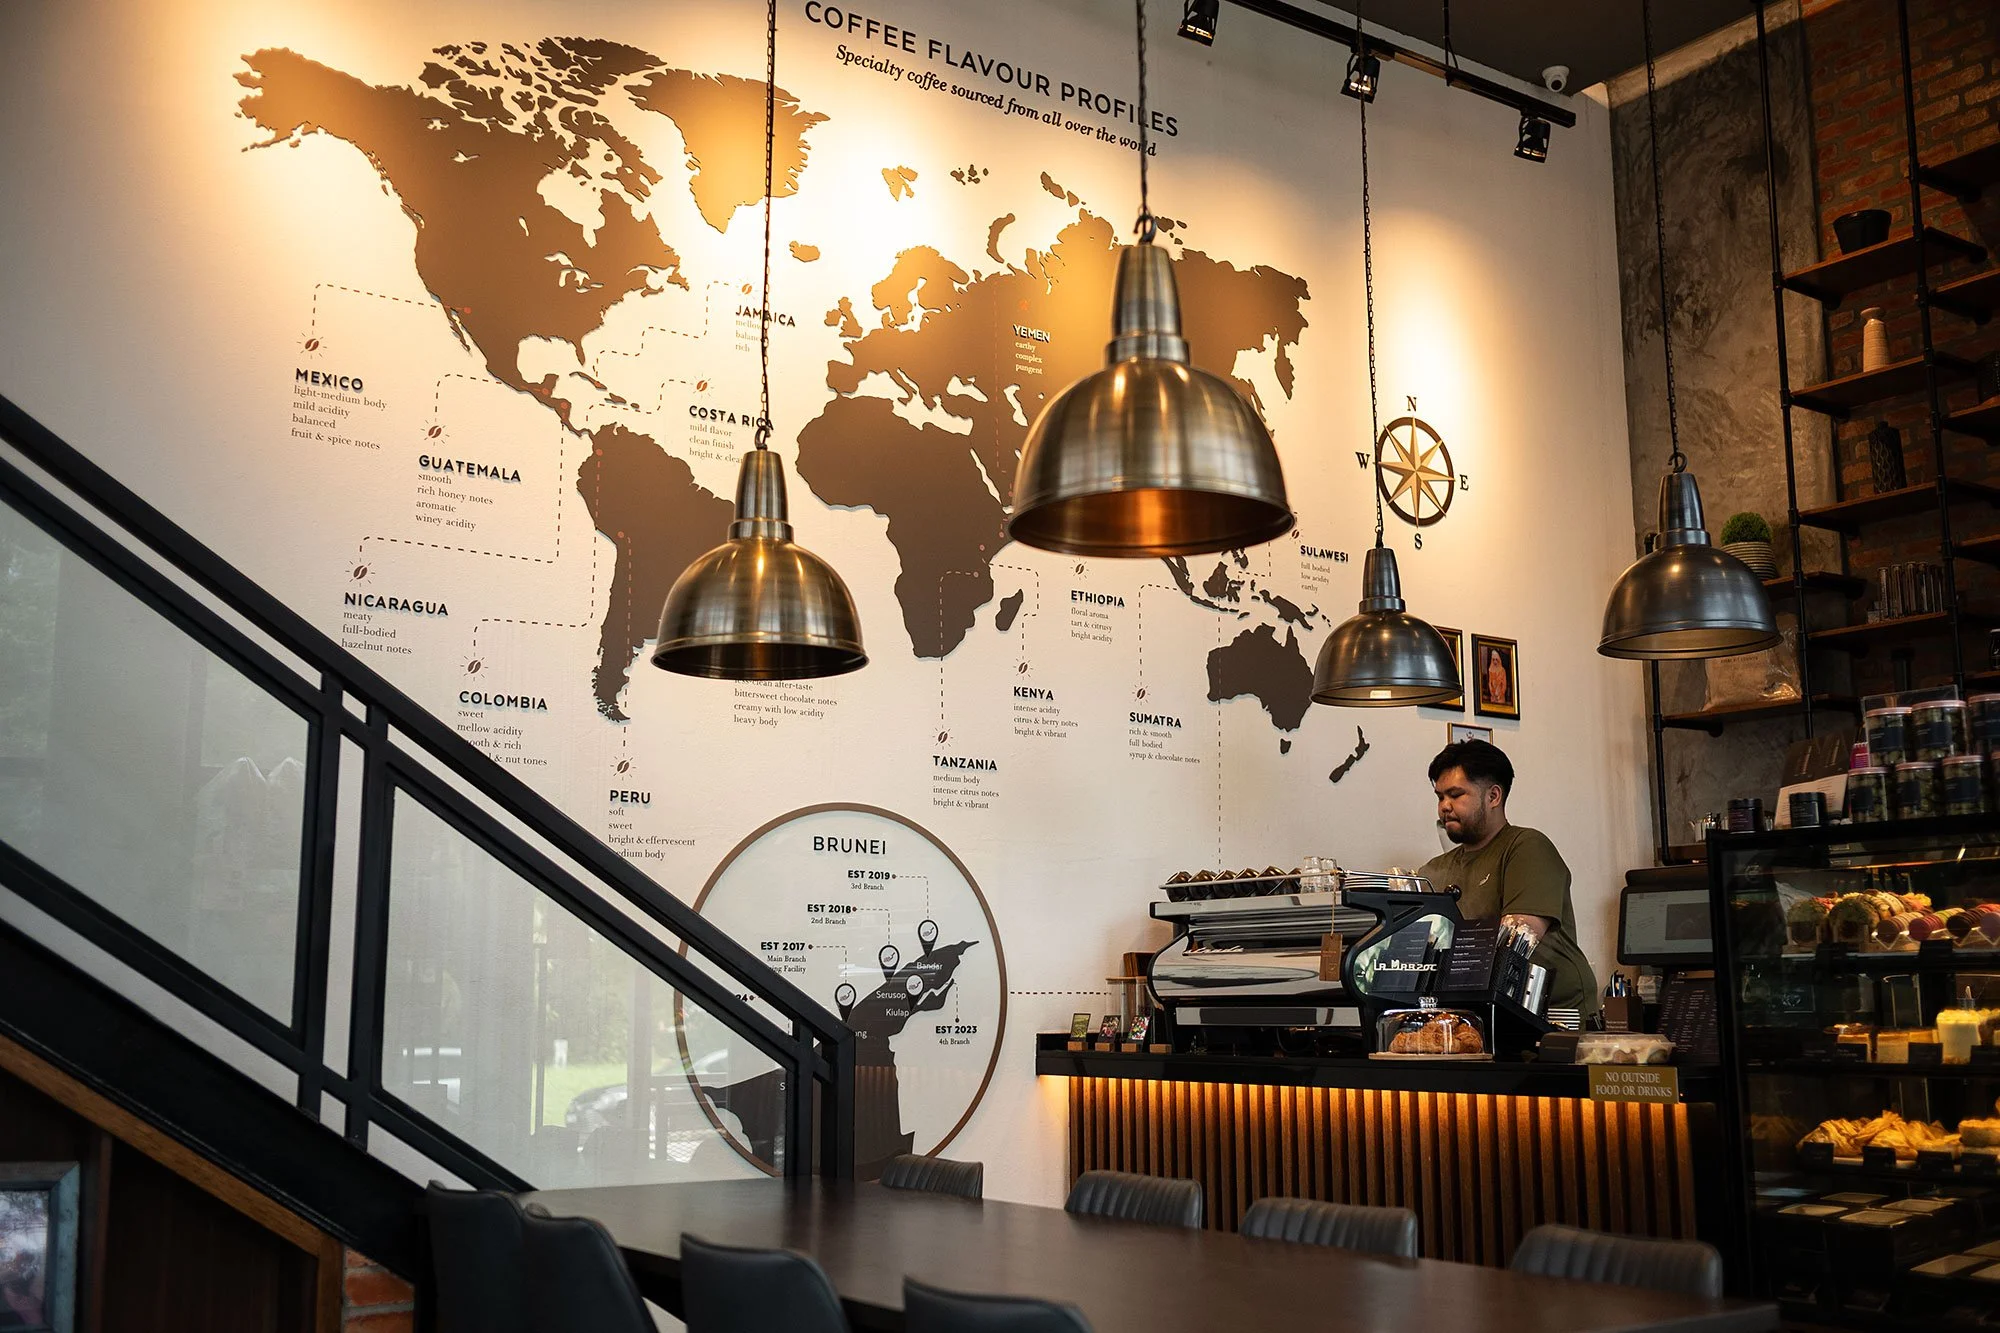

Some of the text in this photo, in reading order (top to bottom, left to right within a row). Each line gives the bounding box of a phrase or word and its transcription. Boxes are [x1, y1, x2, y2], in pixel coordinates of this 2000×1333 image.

[805, 1, 1178, 137] COFFEE FLAVOUR PROFILES
[836, 44, 1157, 157] Specialty coffee sourced from all over the word
[736, 305, 795, 327] JAMAICA
[1013, 324, 1050, 343] YEMEN
[736, 343, 750, 352] rich
[1016, 353, 1042, 363] complex
[1016, 364, 1042, 374] pungent
[296, 368, 363, 390] MEXICO
[294, 385, 387, 411] light-medium body
[1407, 396, 1417, 411] N
[293, 401, 350, 419] mild acidity
[292, 413, 336, 428] balanced
[689, 405, 774, 430] COSTA RICA
[690, 424, 732, 436] mild flavor
[291, 428, 312, 439] fruit
[328, 435, 351, 445] spice
[355, 440, 380, 450] notes
[689, 436, 734, 449] clean finish
[689, 448, 713, 460] bright
[1356, 452, 1370, 469] W
[419, 455, 521, 481] GUATEMALA
[418, 474, 451, 484] smooth
[1460, 475, 1469, 490] E
[417, 486, 493, 504] rich honey notes
[416, 501, 456, 512] aromatic
[416, 514, 476, 531] winey acidity
[1415, 533, 1422, 550] S
[1300, 545, 1348, 562] SULAWESI
[345, 592, 448, 615] NICARAGUA
[1071, 590, 1124, 607] ETHIOPIA
[344, 612, 372, 623] meaty
[1071, 607, 1087, 616] floral
[343, 624, 396, 638] full-bodied
[1071, 630, 1112, 644] bright acidity
[342, 638, 412, 654] hazelnut notes
[735, 688, 837, 705] bittersweet chocolate notes
[1014, 686, 1053, 700] KENYA
[460, 691, 547, 710] COLOMBIA
[734, 704, 824, 719] creamy with low acidity
[1014, 703, 1060, 716] intense acidity
[734, 715, 778, 728] heavy body
[1014, 716, 1032, 724] citrus
[1042, 717, 1059, 728] berry
[1130, 712, 1181, 728] SUMATRA
[457, 723, 523, 738] mellow acidity
[1015, 727, 1034, 737] bright
[467, 739, 489, 747] ooth
[504, 741, 521, 749] rich
[1142, 740, 1162, 748] bodied
[524, 757, 547, 765] tones
[933, 756, 997, 770] TANZANIA
[1129, 752, 1146, 760] syrup
[1155, 753, 1183, 762] chocolate
[933, 774, 980, 786] medium body
[610, 790, 650, 804] PERU
[933, 785, 958, 794] intense
[960, 788, 979, 796] citrus
[933, 798, 954, 808] bright
[965, 800, 988, 808] vibrant
[609, 807, 624, 815] soft
[609, 835, 695, 845] bright & effervescent
[814, 836, 885, 854] BRUNEI
[645, 850, 665, 861] body
[848, 870, 890, 880] EST 2019
[808, 904, 851, 913] EST 2018
[761, 942, 805, 951] EST 2017
[784, 966, 806, 974] Facility
[876, 991, 906, 999] Serusop
[886, 1009, 909, 1017] Kiulap
[936, 1026, 977, 1034] EST 2023
[1605, 1072, 1660, 1083] NO OUTSIDE
[1596, 1085, 1672, 1097] FOOD OR DRINKS
